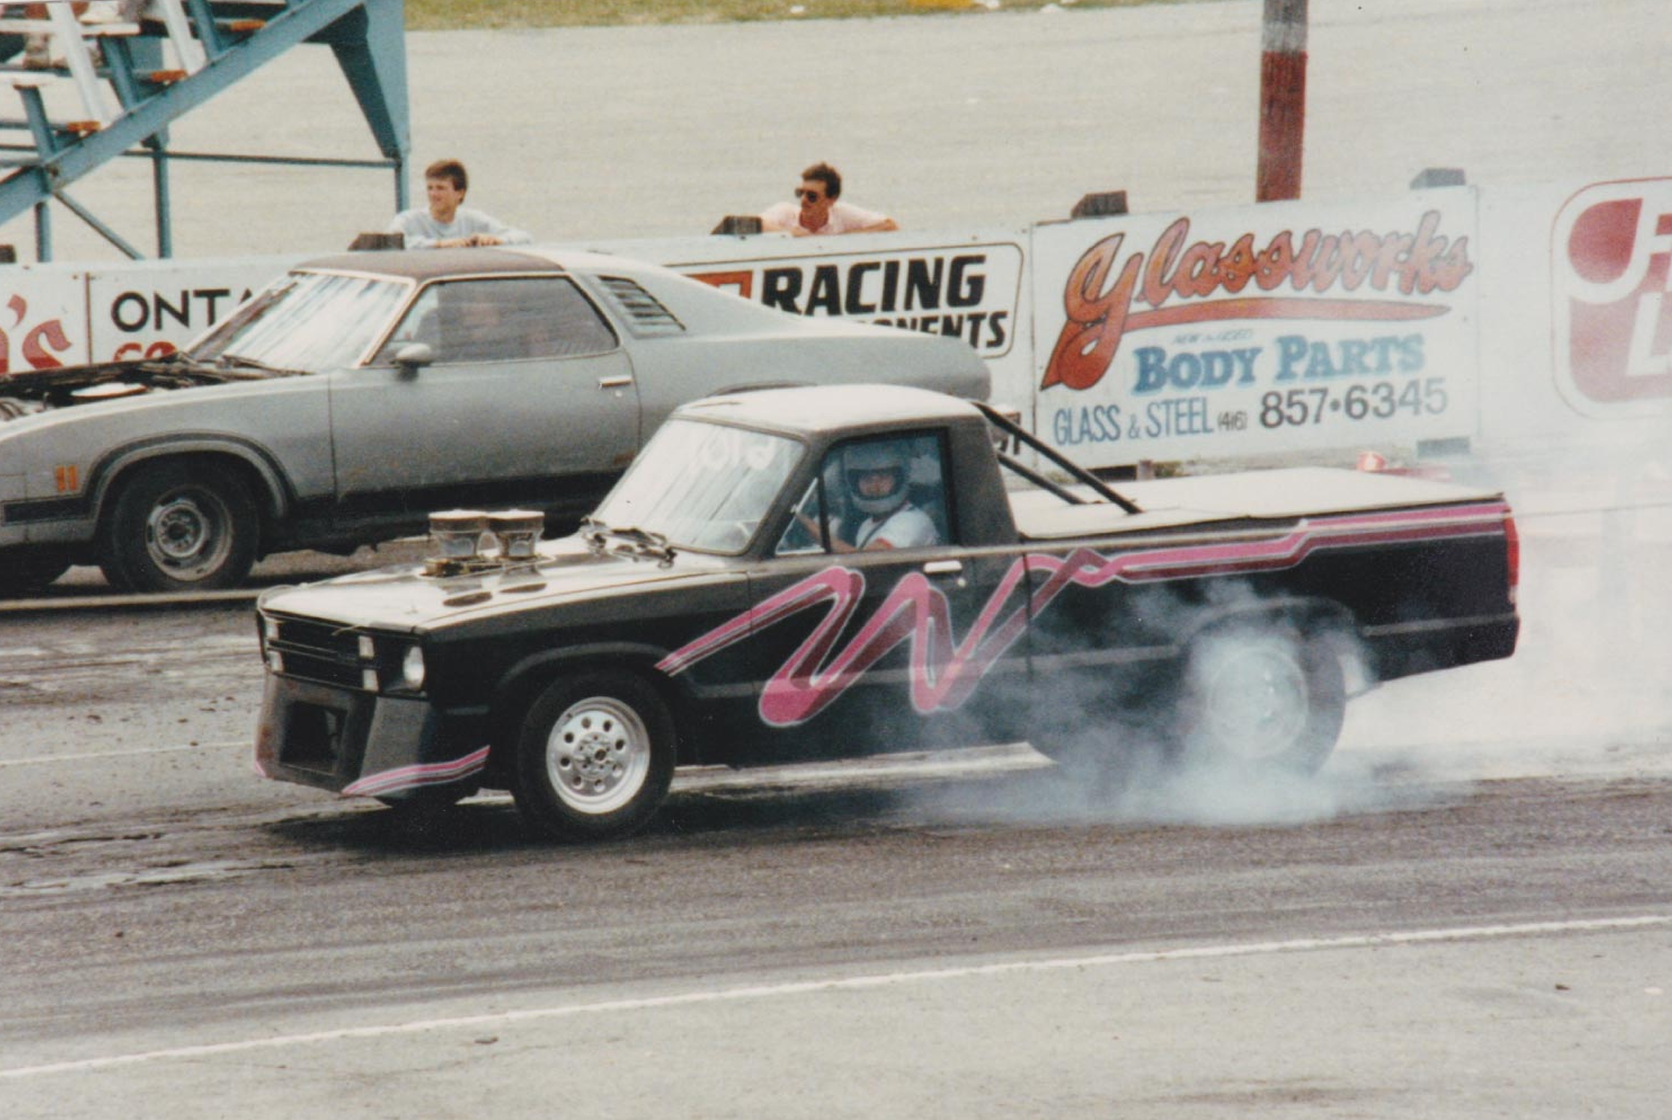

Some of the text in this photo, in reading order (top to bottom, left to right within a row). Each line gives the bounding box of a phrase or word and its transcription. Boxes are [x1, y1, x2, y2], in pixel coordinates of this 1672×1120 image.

[111, 288, 252, 332] ONT
[761, 254, 987, 318] RACING
[1131, 333, 1425, 396] BODY PARTS
[1053, 404, 1121, 446] GLASS
[1128, 413, 1141, 440] &
[1146, 397, 1214, 438] STEEL
